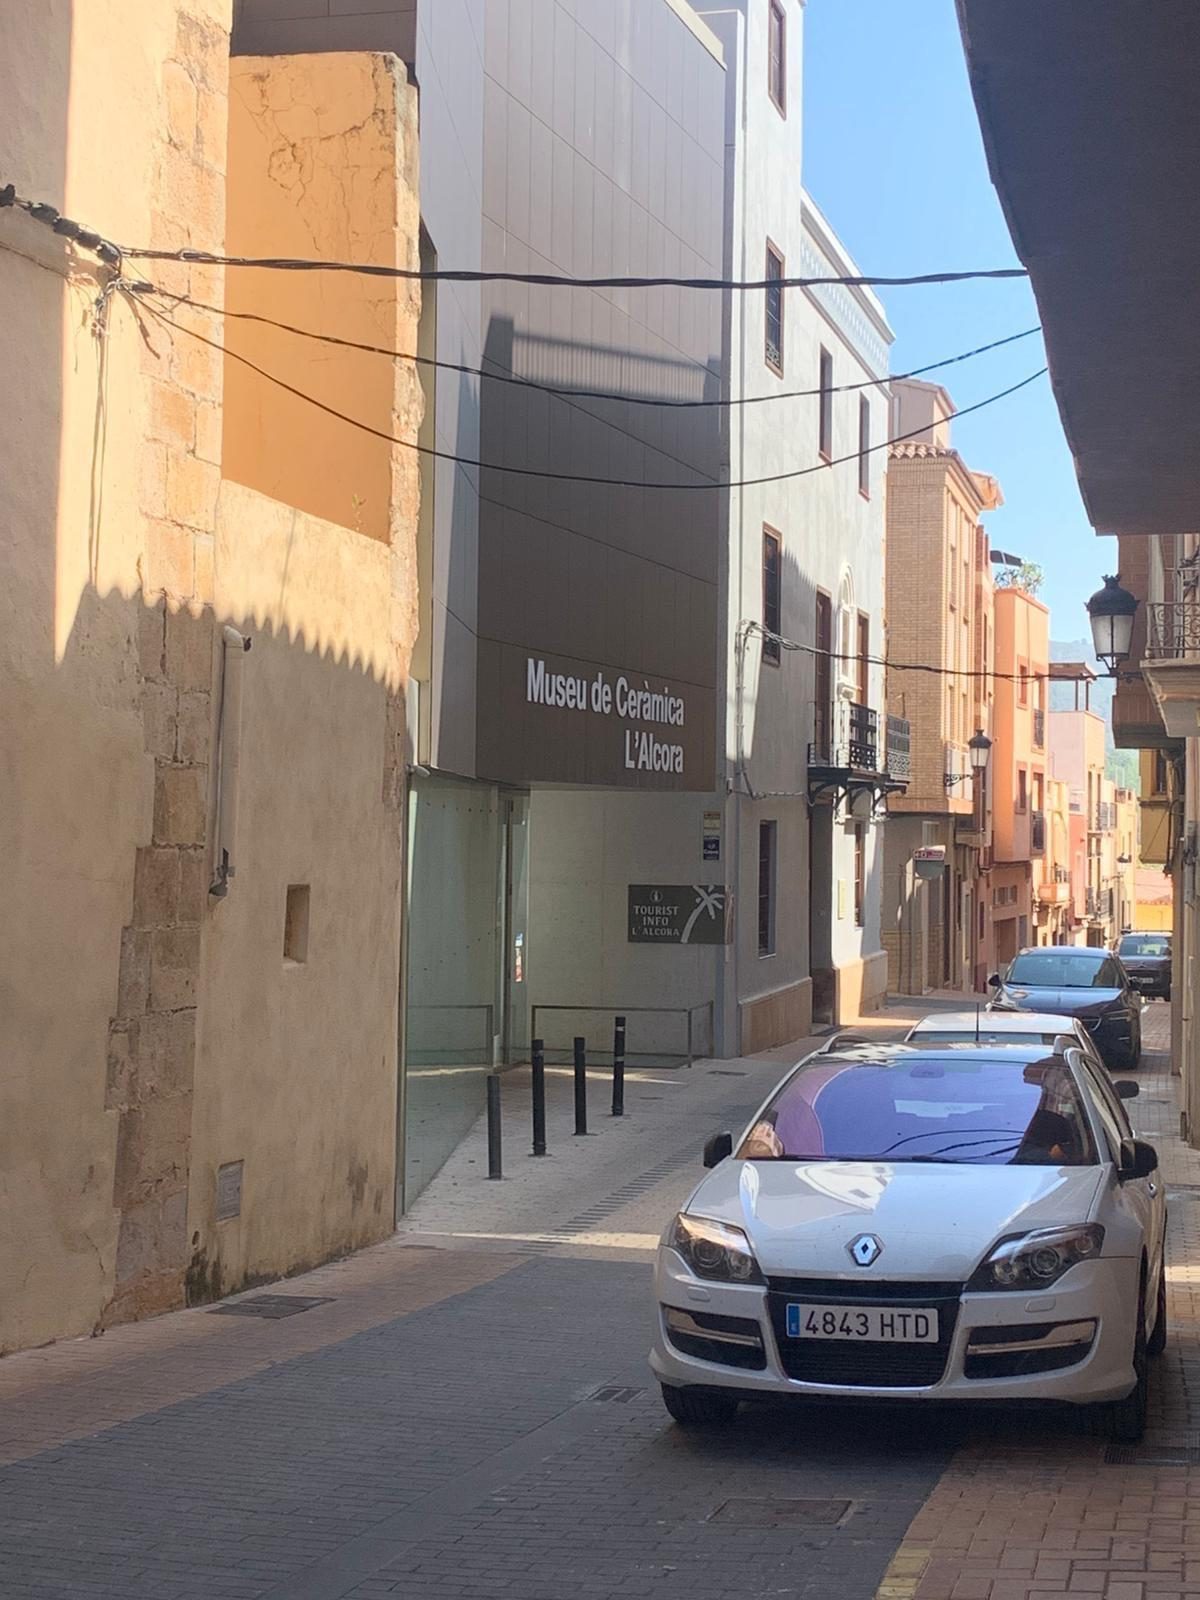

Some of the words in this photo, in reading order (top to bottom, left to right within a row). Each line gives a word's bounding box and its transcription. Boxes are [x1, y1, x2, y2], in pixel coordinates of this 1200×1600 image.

[527, 658, 587, 711] Museu
[591, 672, 612, 714] de
[616, 676, 684, 726] Ceràmica
[625, 729, 683, 773] L'Alcora
[633, 905, 679, 915] TOURIST
[643, 916, 669, 926] INFO
[805, 1310, 869, 1336] 4843
[880, 1313, 929, 1338] HTD
